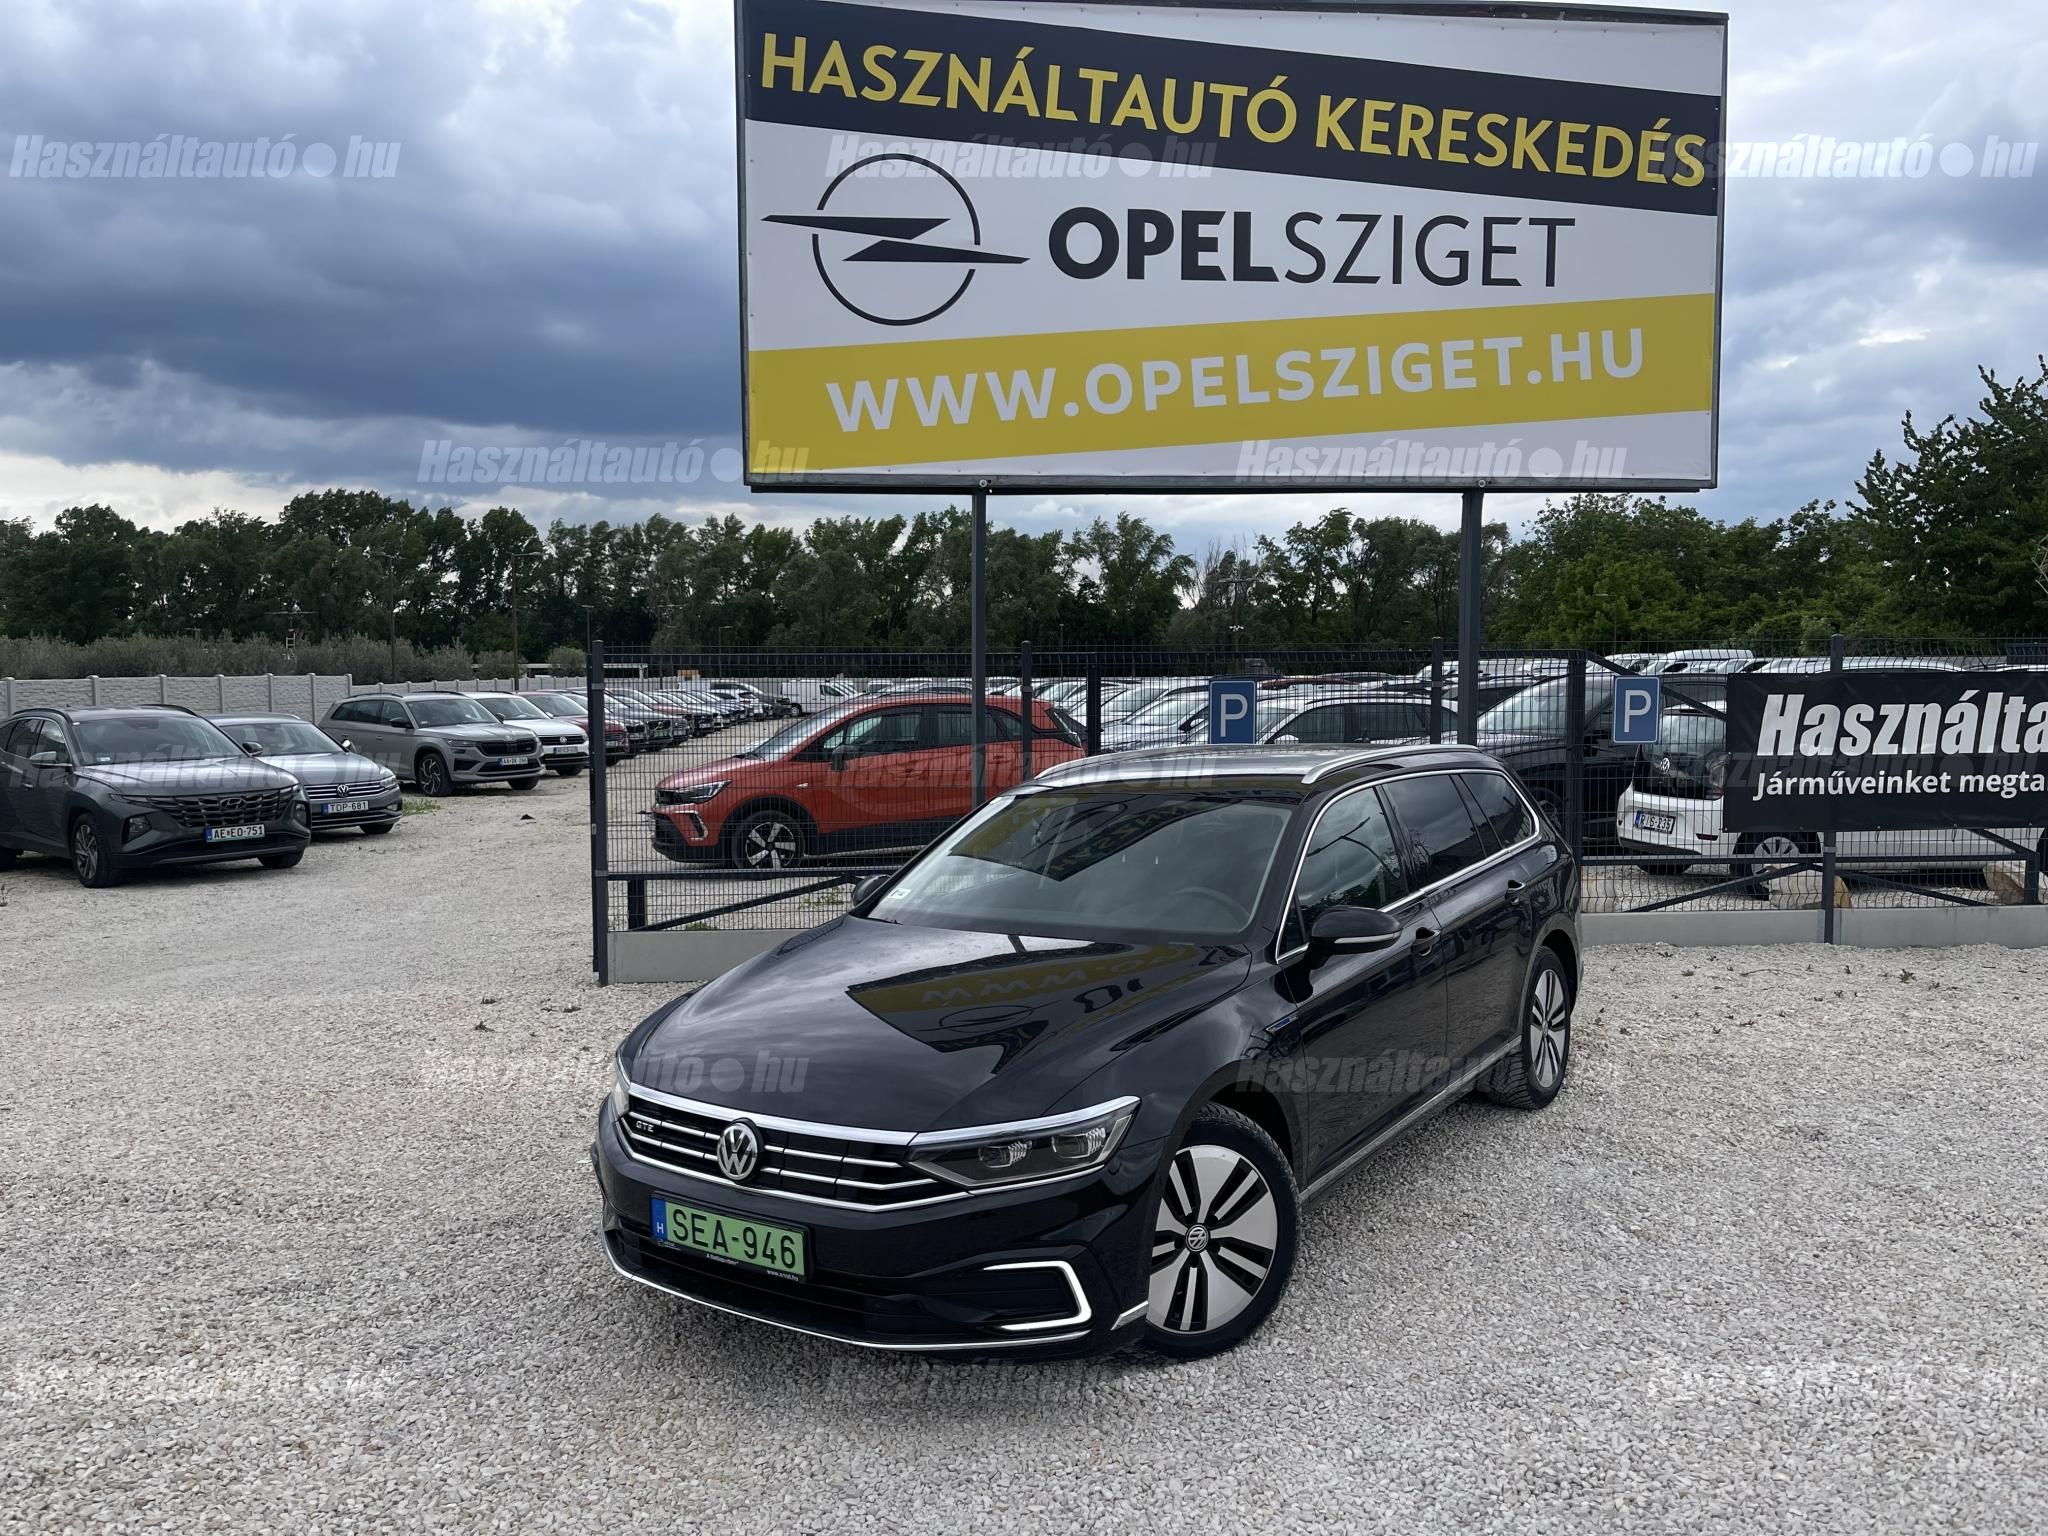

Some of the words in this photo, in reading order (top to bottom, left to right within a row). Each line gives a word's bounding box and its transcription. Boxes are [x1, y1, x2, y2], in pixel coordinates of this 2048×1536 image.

[761, 32, 1298, 143] HASZNÁLTAUTÓ
[1315, 94, 1708, 188] KERESKEDÉS
[1048, 206, 1577, 288] OPELSZIGET
[825, 326, 1645, 433] WWW.OPELSZIGET.HU
[1220, 693, 1248, 737] P
[1624, 689, 1652, 733] P
[1756, 690, 2048, 757] Használta
[1753, 769, 1951, 801] Járműveinket
[636, 1120, 655, 1133] GTE
[672, 1208, 796, 1269] SEA-946
